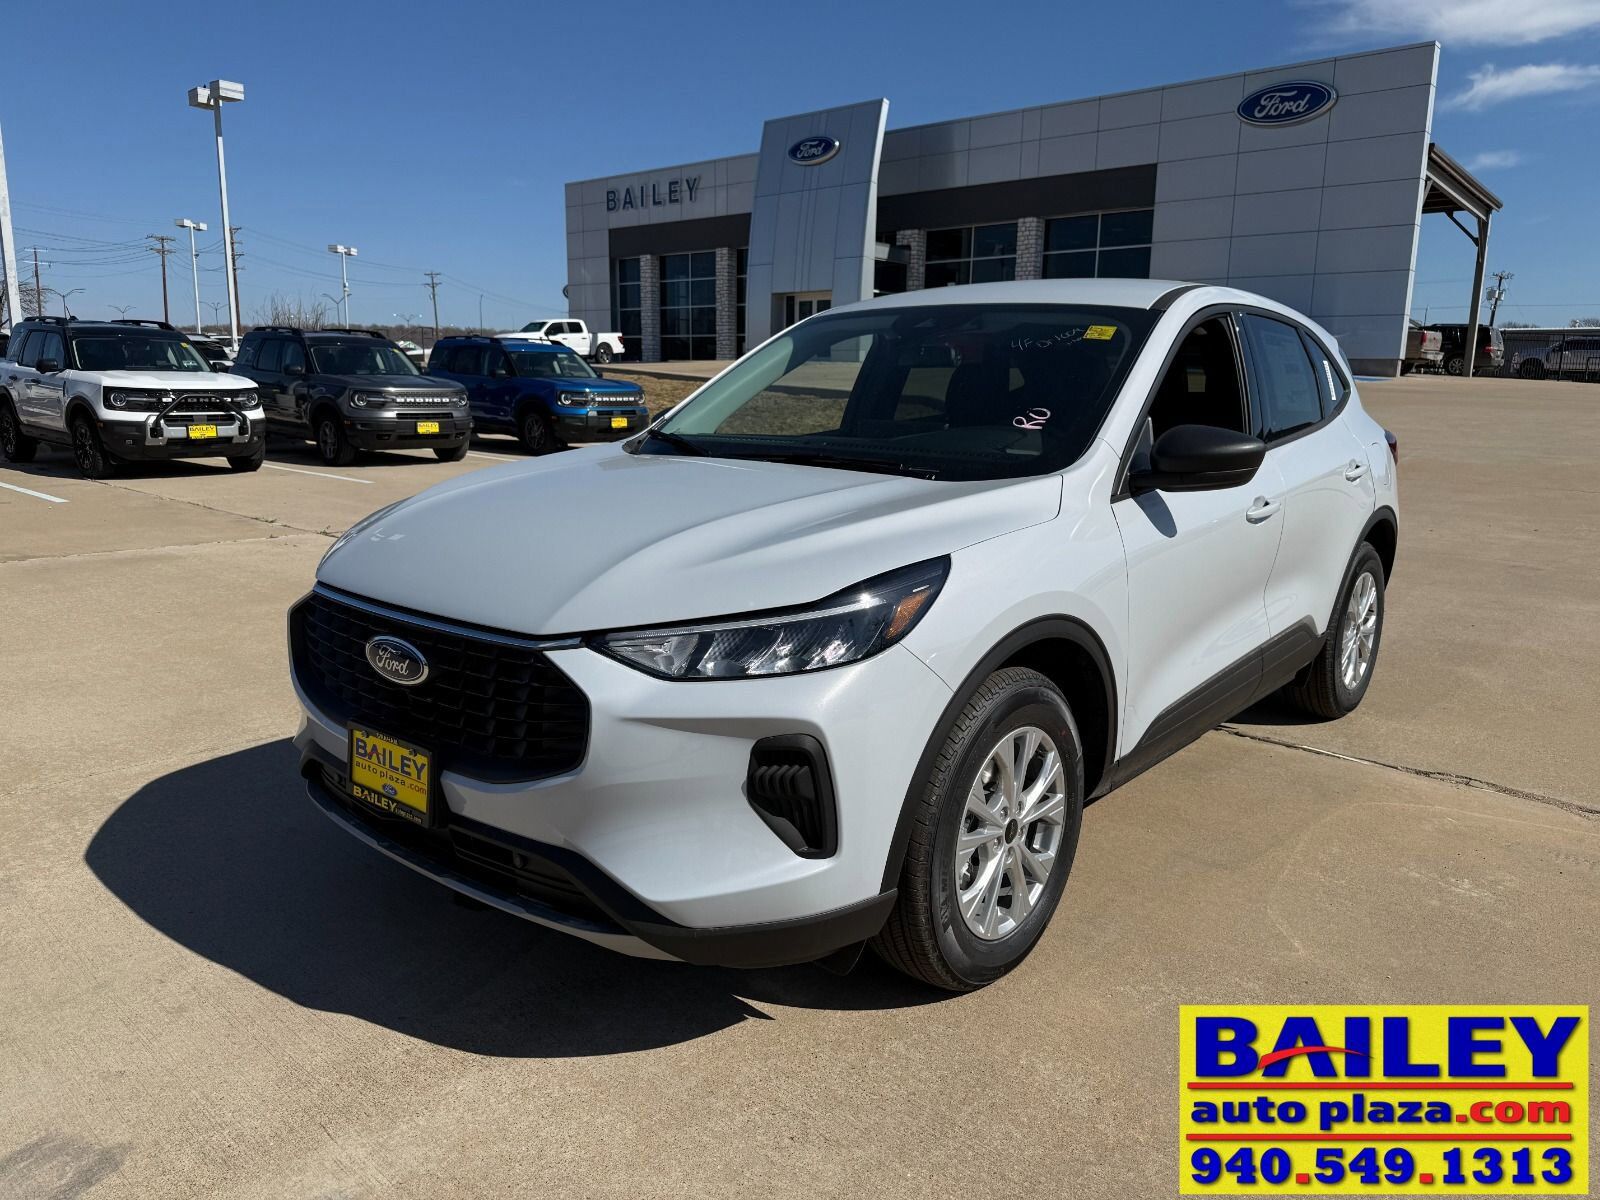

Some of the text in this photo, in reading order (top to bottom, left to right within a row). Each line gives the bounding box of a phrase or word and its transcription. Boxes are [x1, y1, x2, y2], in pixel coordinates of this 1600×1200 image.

[1254, 90, 1312, 118] Ford
[796, 140, 826, 158] Ford
[606, 177, 699, 211] BAILEY
[375, 644, 409, 676] Ford
[355, 737, 427, 781] BAILEY
[355, 760, 378, 776] auto
[353, 785, 397, 813] BAILEY
